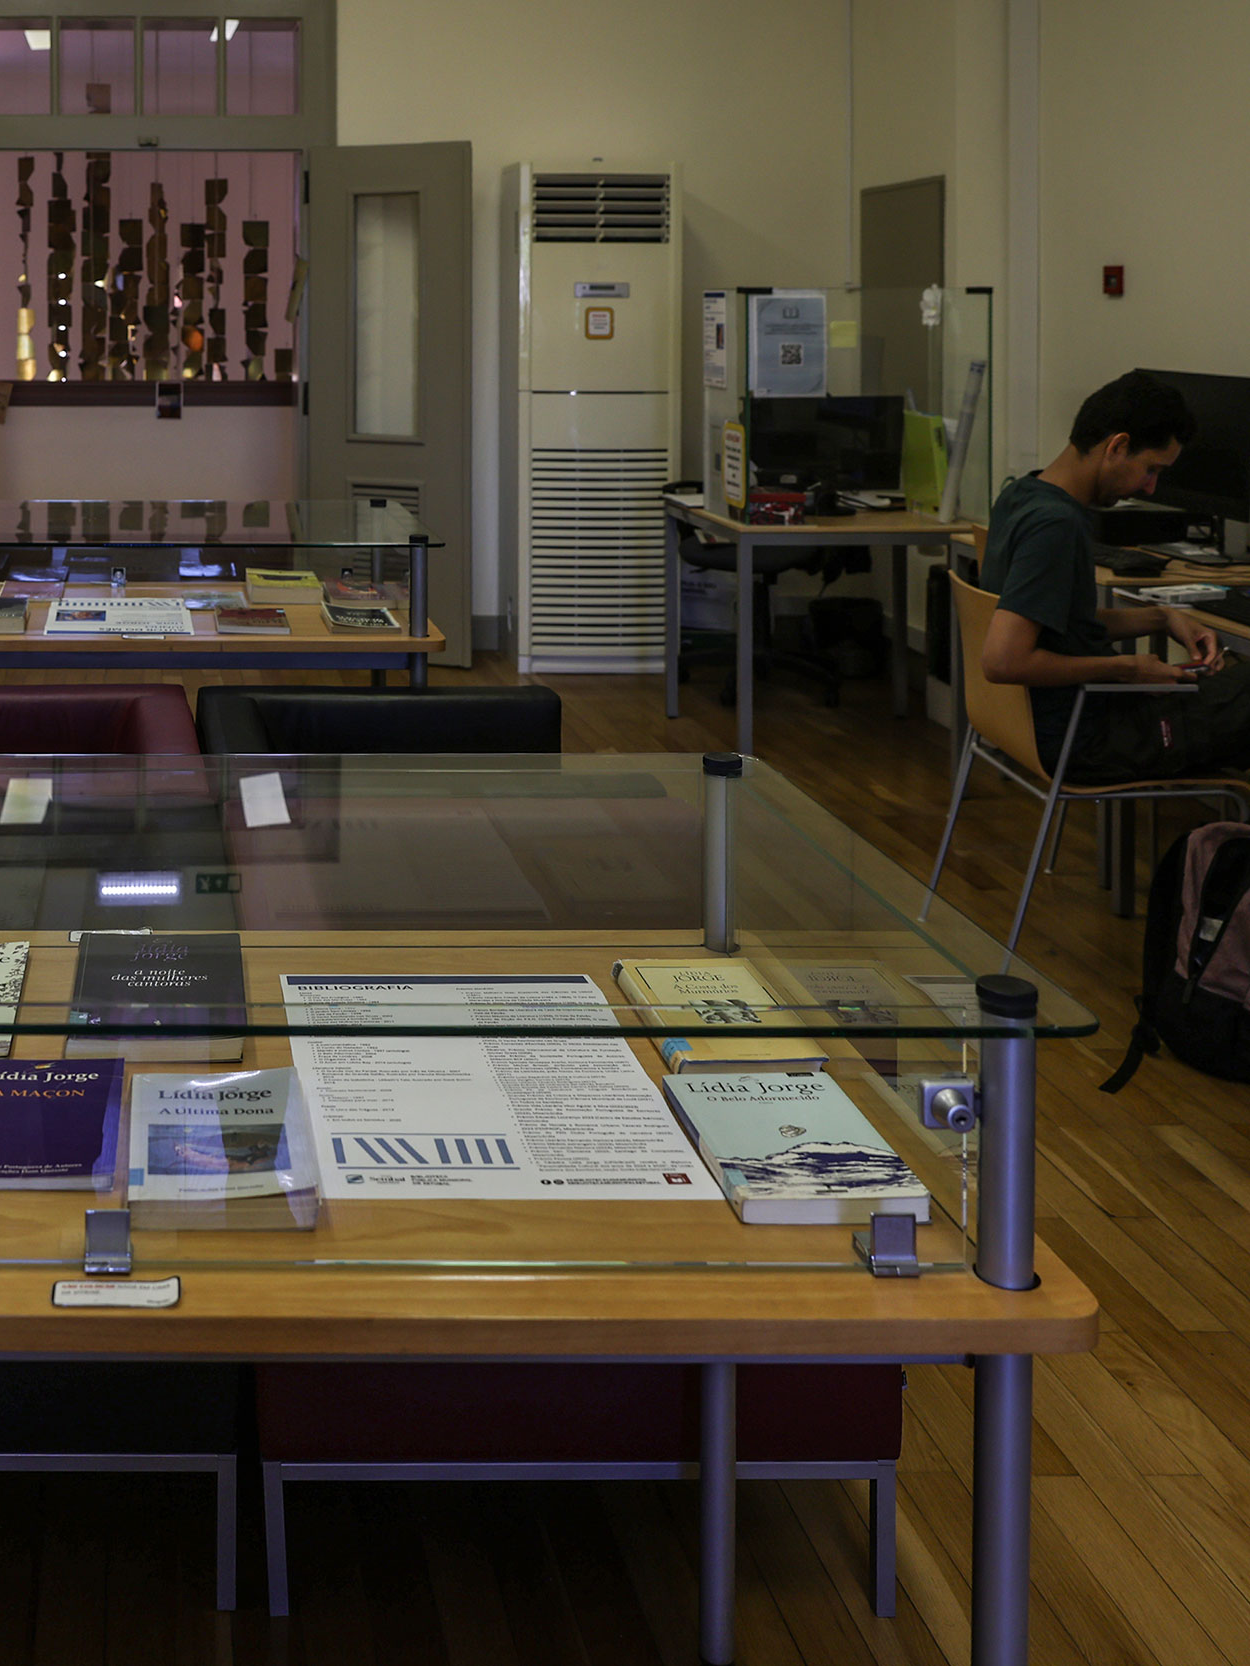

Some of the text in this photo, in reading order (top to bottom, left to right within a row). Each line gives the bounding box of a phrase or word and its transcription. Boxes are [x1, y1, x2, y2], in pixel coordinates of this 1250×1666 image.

[149, 968, 186, 976] noite
[111, 973, 209, 982] das mulheres
[673, 974, 726, 983] JORGE
[127, 980, 192, 988] cantoras
[297, 983, 414, 992] BIBLIOGRAFIA
[42, 1071, 100, 1083] Jorge
[685, 1080, 826, 1095] Lídia Jorge
[10, 1089, 87, 1099] MAÇON
[158, 1088, 272, 1102] Lídia Jorge
[749, 1094, 821, 1102] Adormecido
[159, 1105, 275, 1116] A Última Dona
